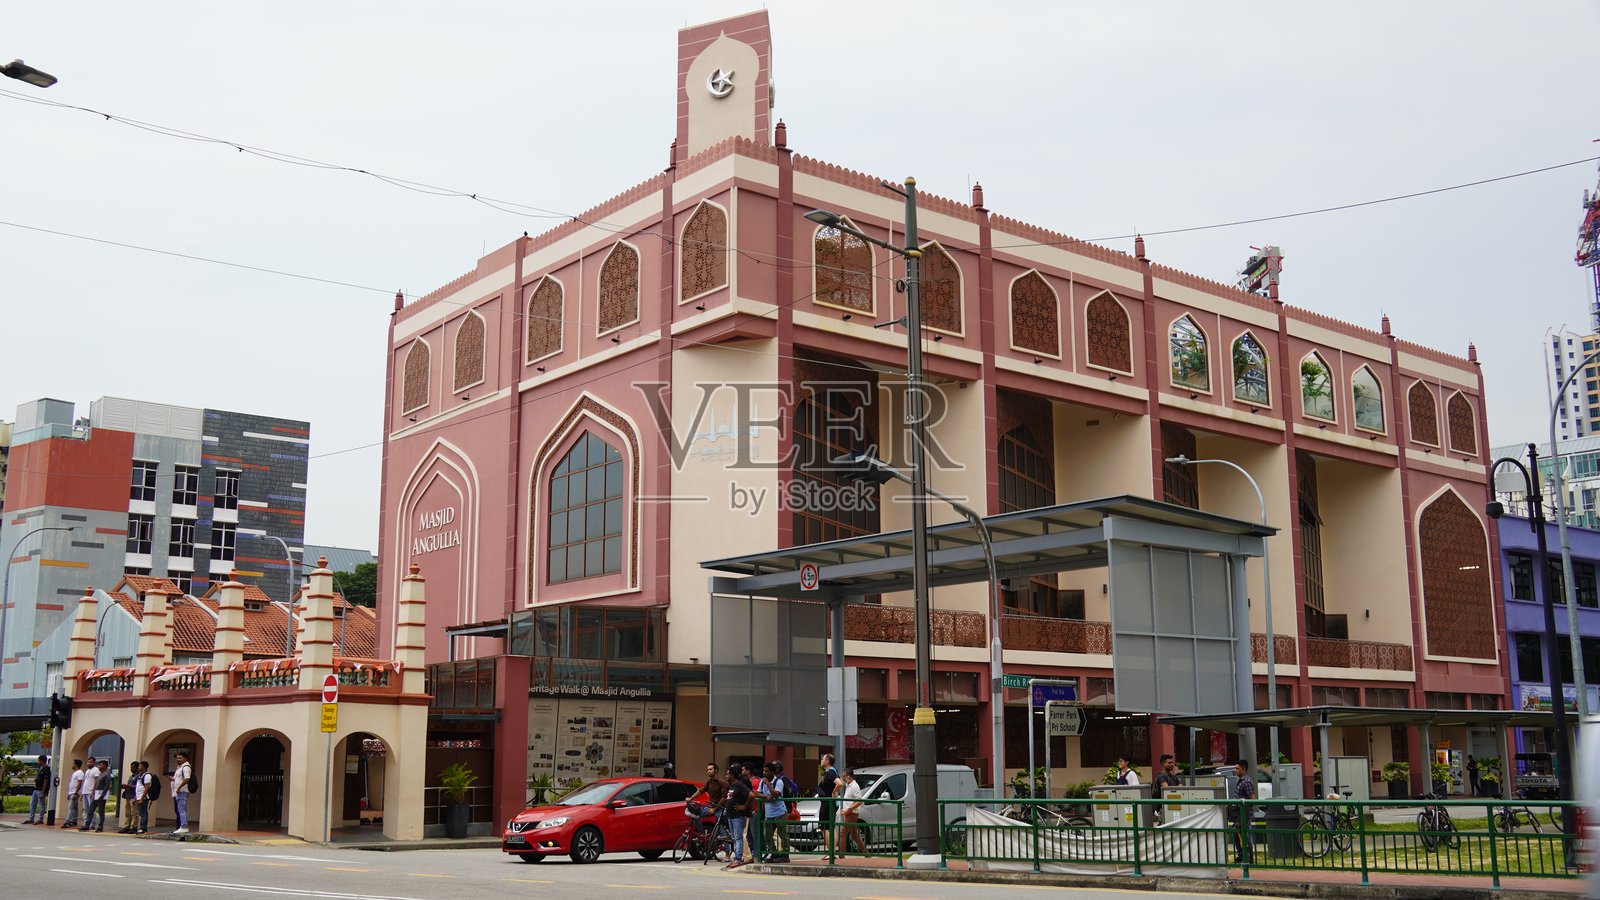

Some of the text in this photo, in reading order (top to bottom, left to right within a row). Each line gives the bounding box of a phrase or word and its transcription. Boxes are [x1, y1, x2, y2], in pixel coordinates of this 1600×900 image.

[419, 507, 455, 531] MASJID
[412, 529, 460, 557] ANGULLIA
[1004, 676, 1020, 686] Birch
[592, 686, 618, 696] Masjid
[620, 688, 651, 698] Angullia
[1050, 711, 1077, 720] Farrer Park
[1060, 723, 1076, 732] School
